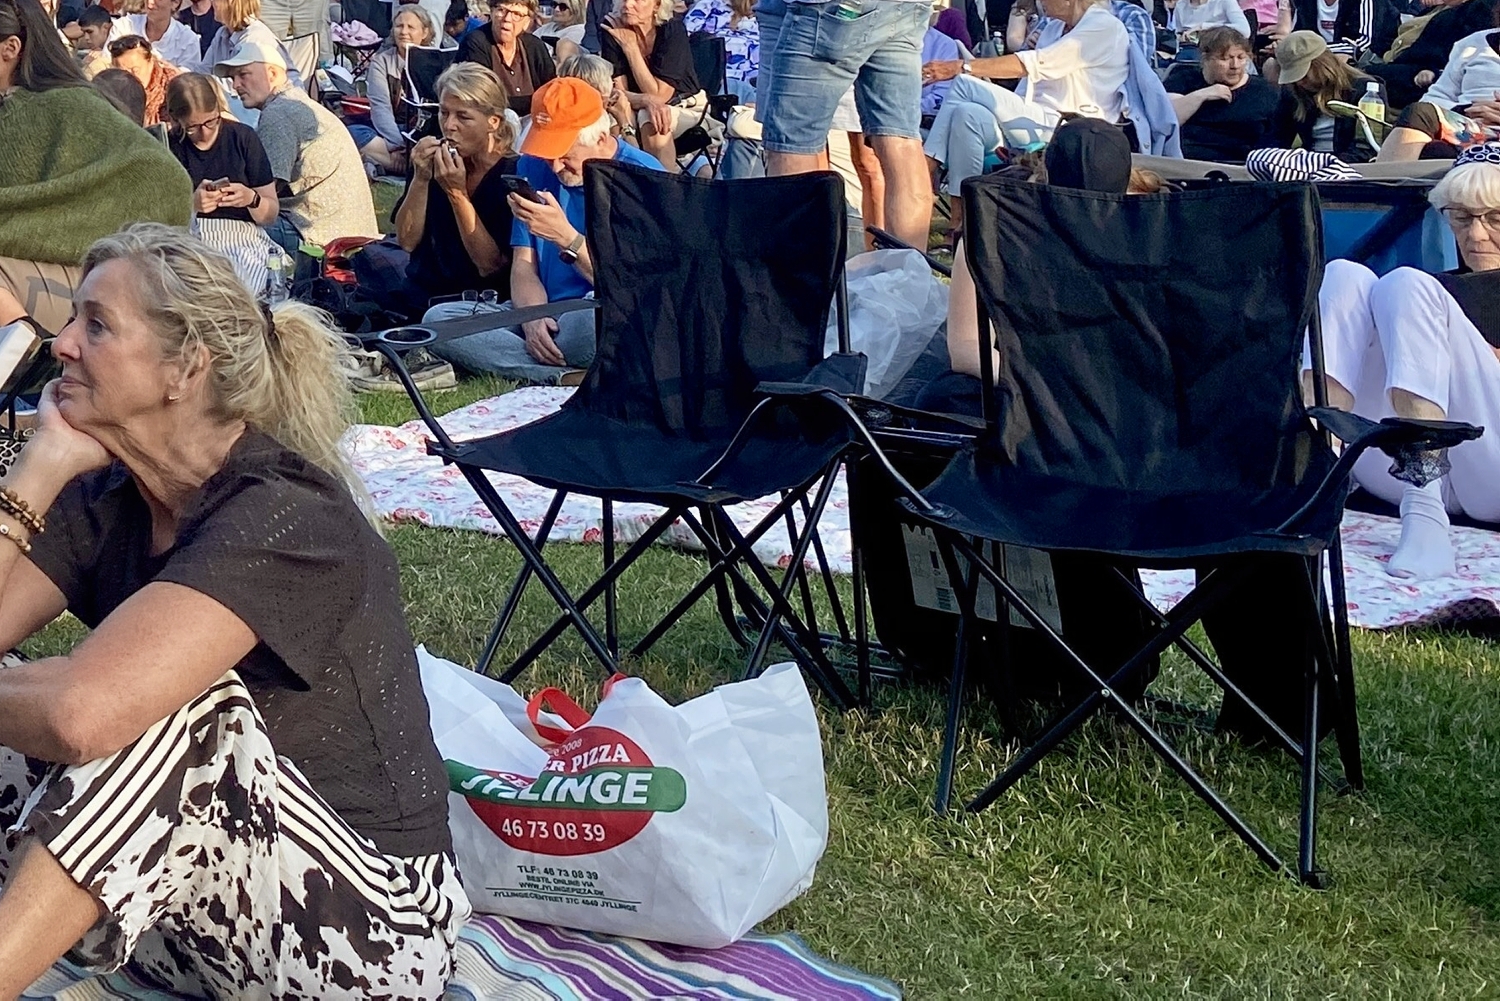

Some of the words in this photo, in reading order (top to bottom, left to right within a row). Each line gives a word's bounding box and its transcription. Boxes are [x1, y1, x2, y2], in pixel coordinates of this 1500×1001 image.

[570, 743, 631, 773] PIZZA
[502, 818, 524, 838] 46
[527, 820, 549, 839] 73
[553, 822, 578, 841] 08
[581, 823, 606, 843] 39
[557, 868, 570, 877] 73
[571, 870, 584, 879] 08
[586, 871, 599, 880] 39
